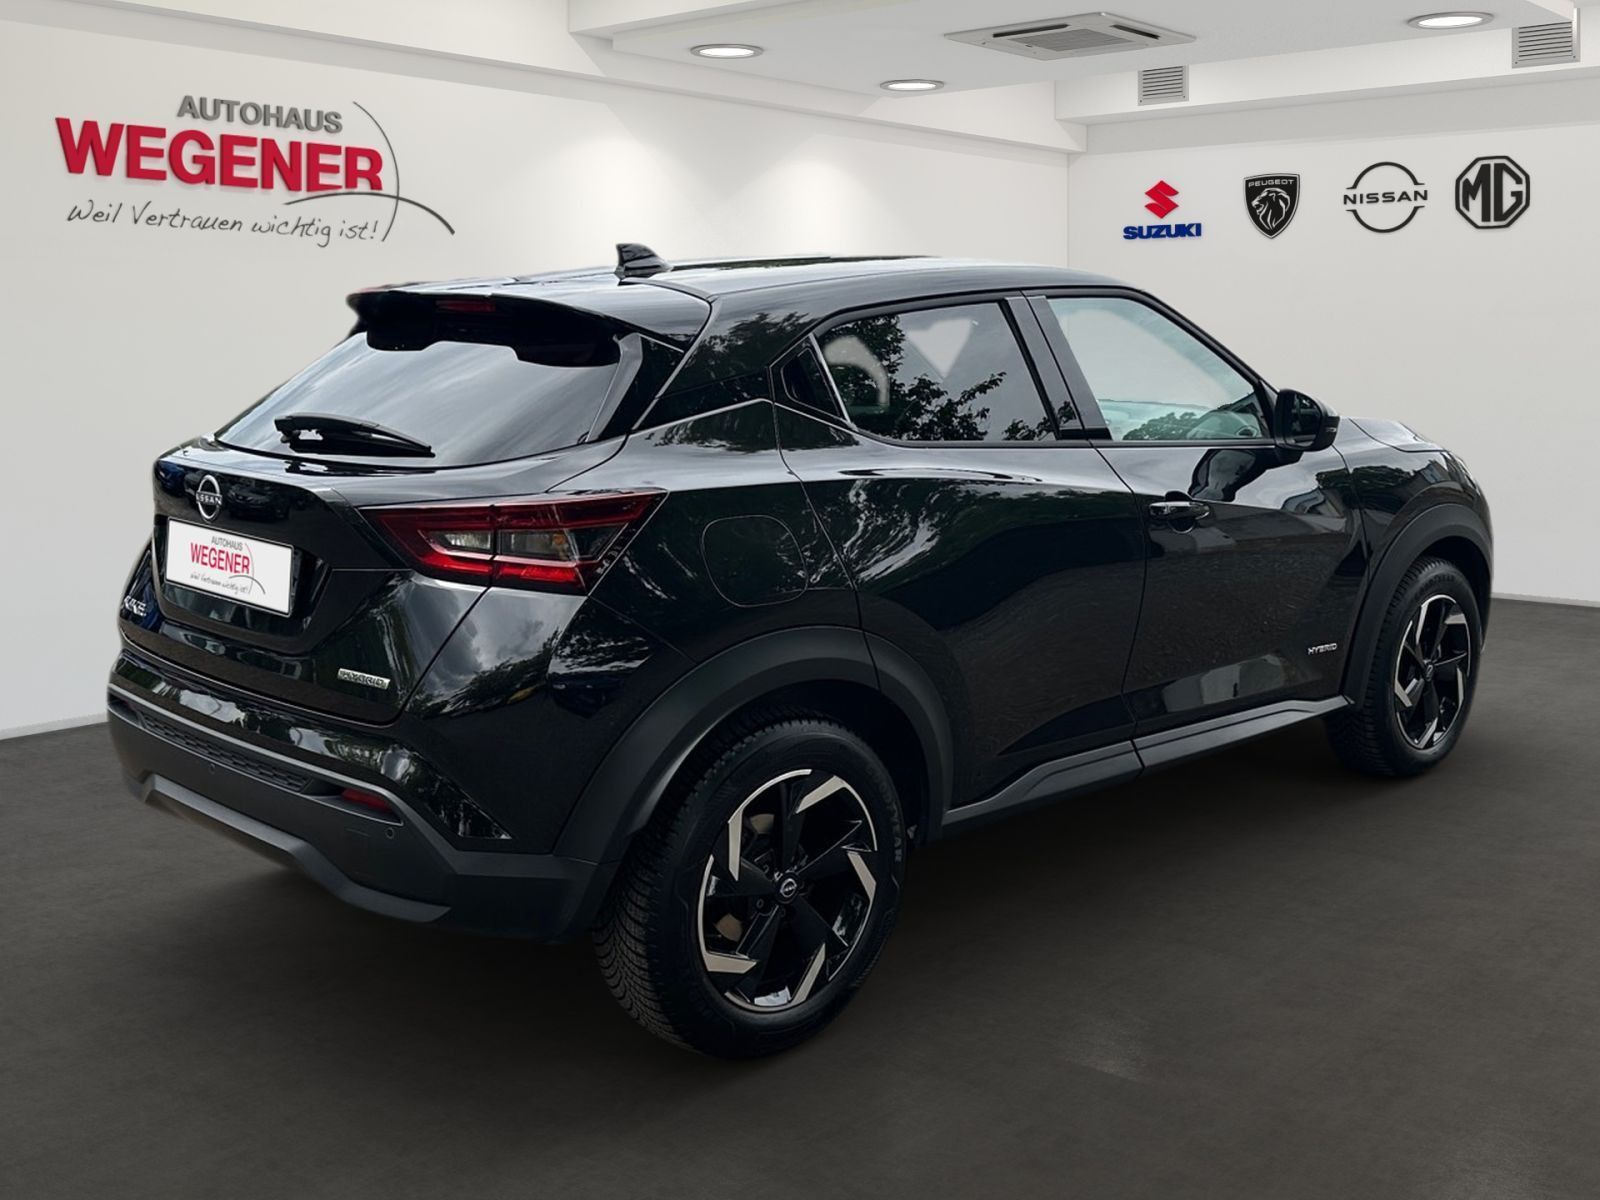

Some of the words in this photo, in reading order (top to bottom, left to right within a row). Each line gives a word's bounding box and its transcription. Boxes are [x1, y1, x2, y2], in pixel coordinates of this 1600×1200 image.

[177, 95, 343, 134] AUTOHAUS
[55, 117, 384, 193] WEGENER
[1248, 178, 1295, 188] PEUGEOT
[1343, 188, 1429, 206] NISSAN
[1461, 162, 1524, 224] MG
[67, 199, 123, 223] Weil
[132, 200, 243, 232] Vertrauen
[251, 215, 331, 248] wichtig
[339, 220, 379, 240] ist!
[1123, 222, 1202, 240] SUZUKI
[190, 541, 250, 574] WEGENER
[211, 535, 243, 551] AUTOHAUS
